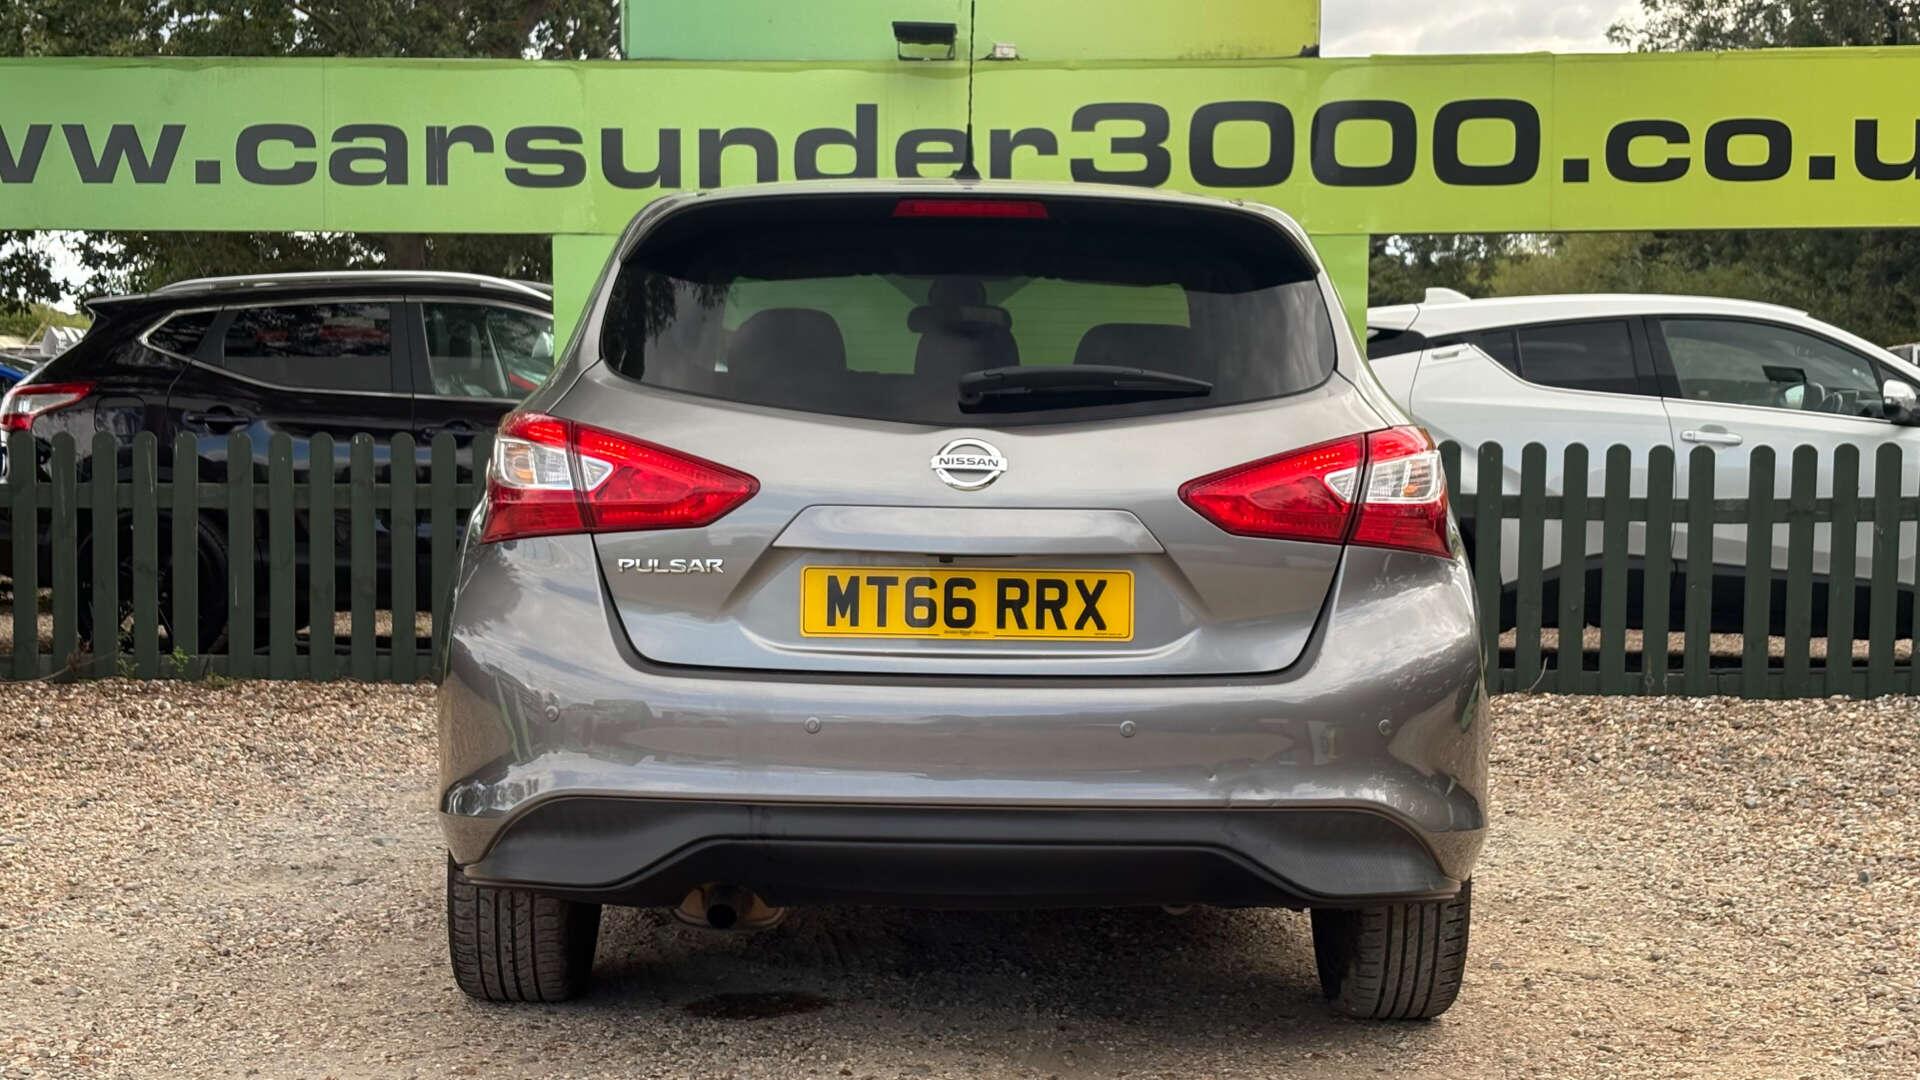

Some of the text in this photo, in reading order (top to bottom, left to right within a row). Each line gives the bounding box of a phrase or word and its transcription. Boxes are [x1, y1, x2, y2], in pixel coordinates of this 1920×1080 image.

[939, 456, 999, 467] NISSAN
[617, 558, 724, 573] PULSAR
[826, 575, 1107, 631] MT66 RRX
